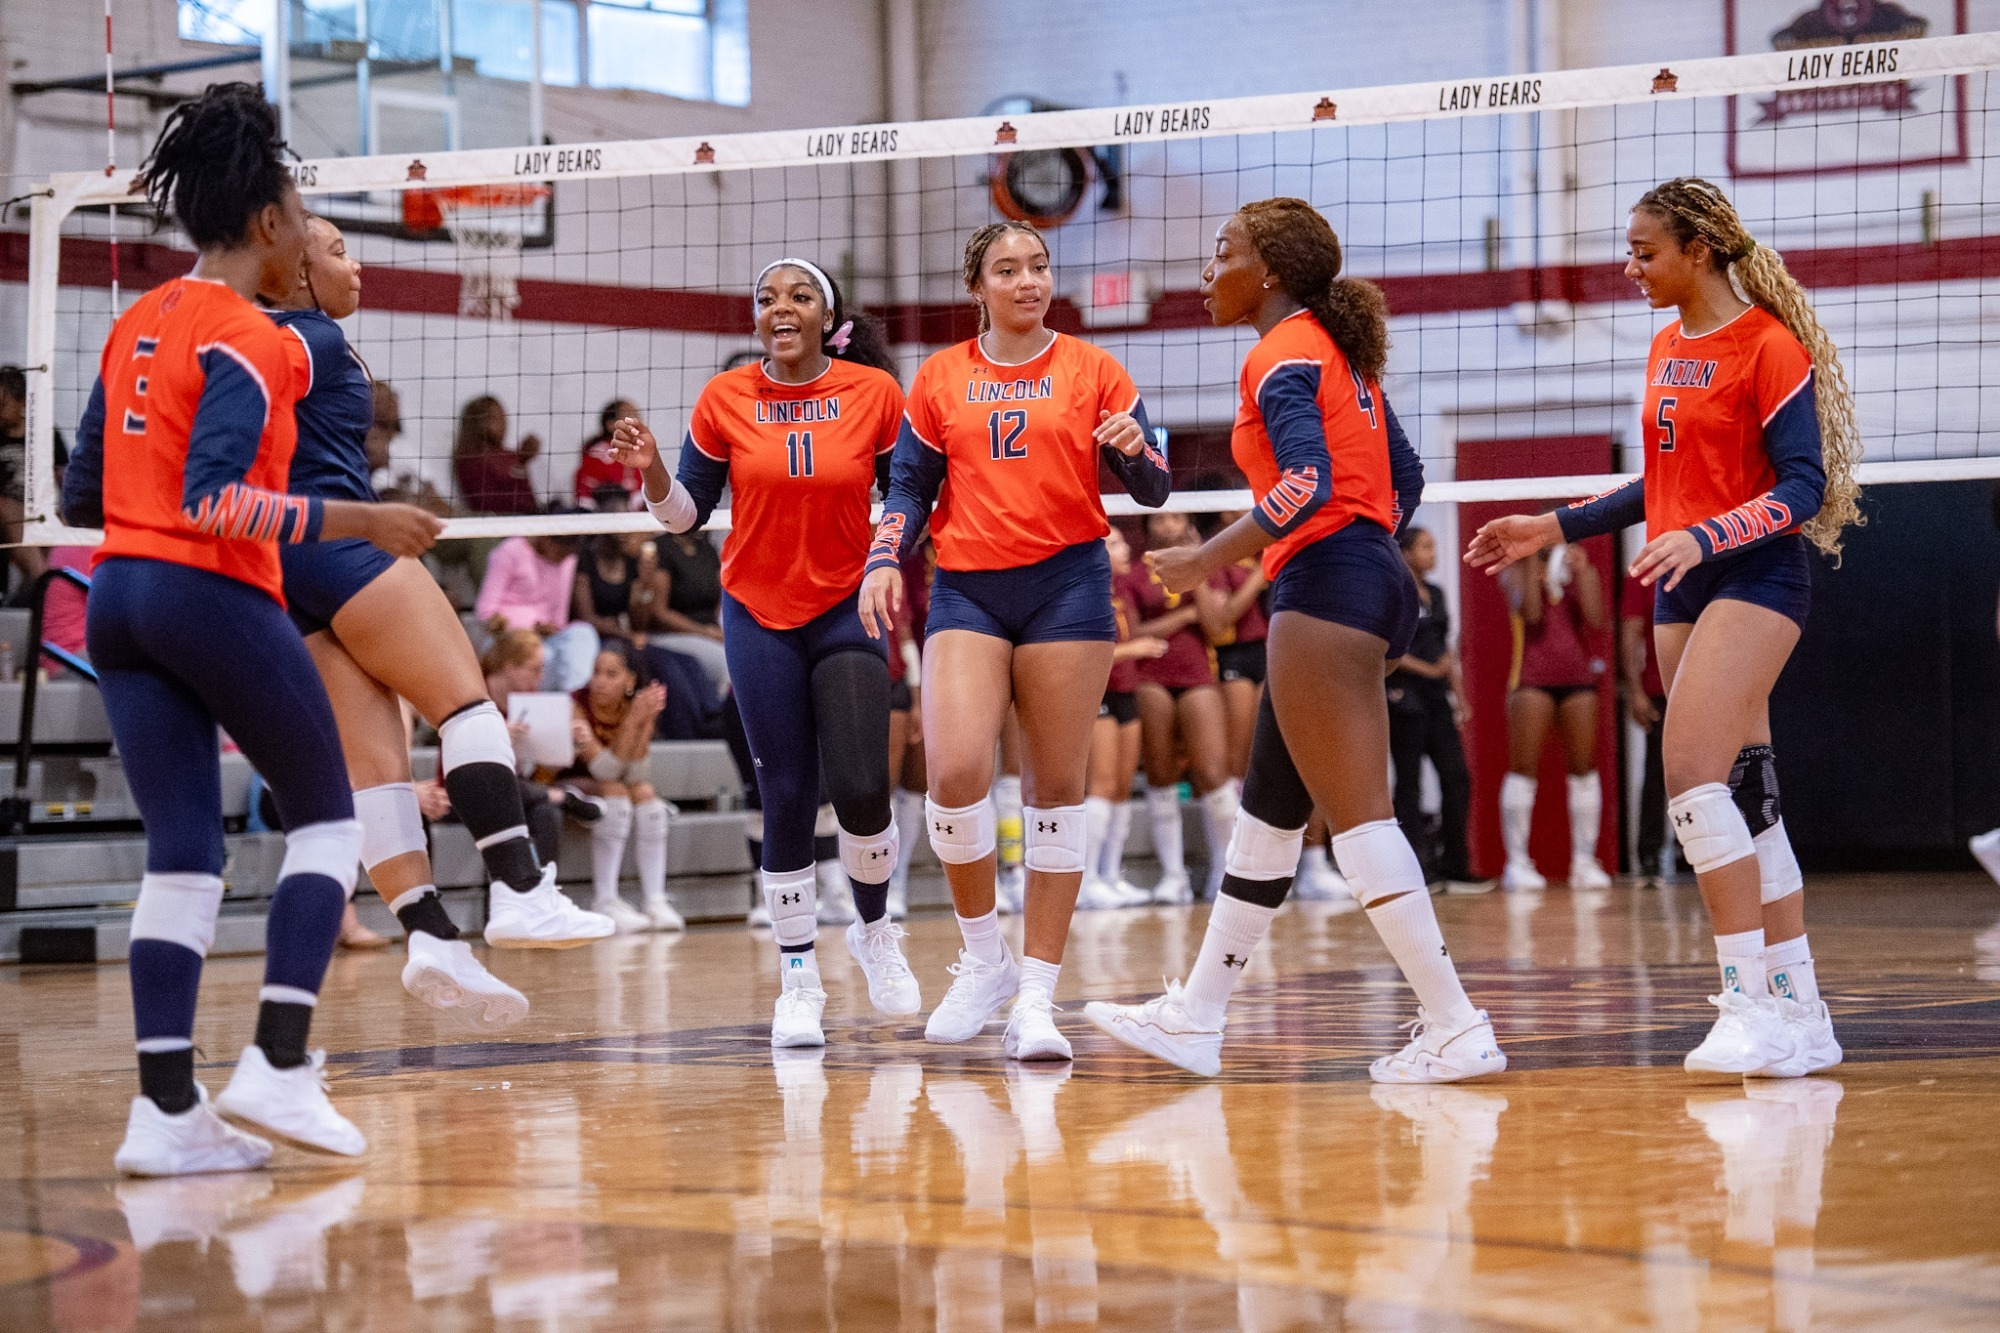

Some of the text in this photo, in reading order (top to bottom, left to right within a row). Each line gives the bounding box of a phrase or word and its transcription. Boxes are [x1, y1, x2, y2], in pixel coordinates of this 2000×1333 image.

[1787, 47, 1899, 82] LADY BEARS
[1439, 80, 1542, 111] LADY BEARS
[1114, 107, 1210, 136] LADY BEARS
[807, 130, 898, 157] LADY BEARS
[291, 165, 318, 188] ARS
[514, 149, 602, 176] LADY BEARS
[1651, 357, 1718, 389] LNCOLN
[966, 375, 1052, 403] LINCOLN
[1347, 360, 1377, 430] 4
[756, 397, 840, 424] LINCOLN
[1657, 397, 1678, 452] 5
[987, 408, 1028, 460] 12
[786, 431, 814, 477] 11
[1692, 492, 1792, 554] LIONS
